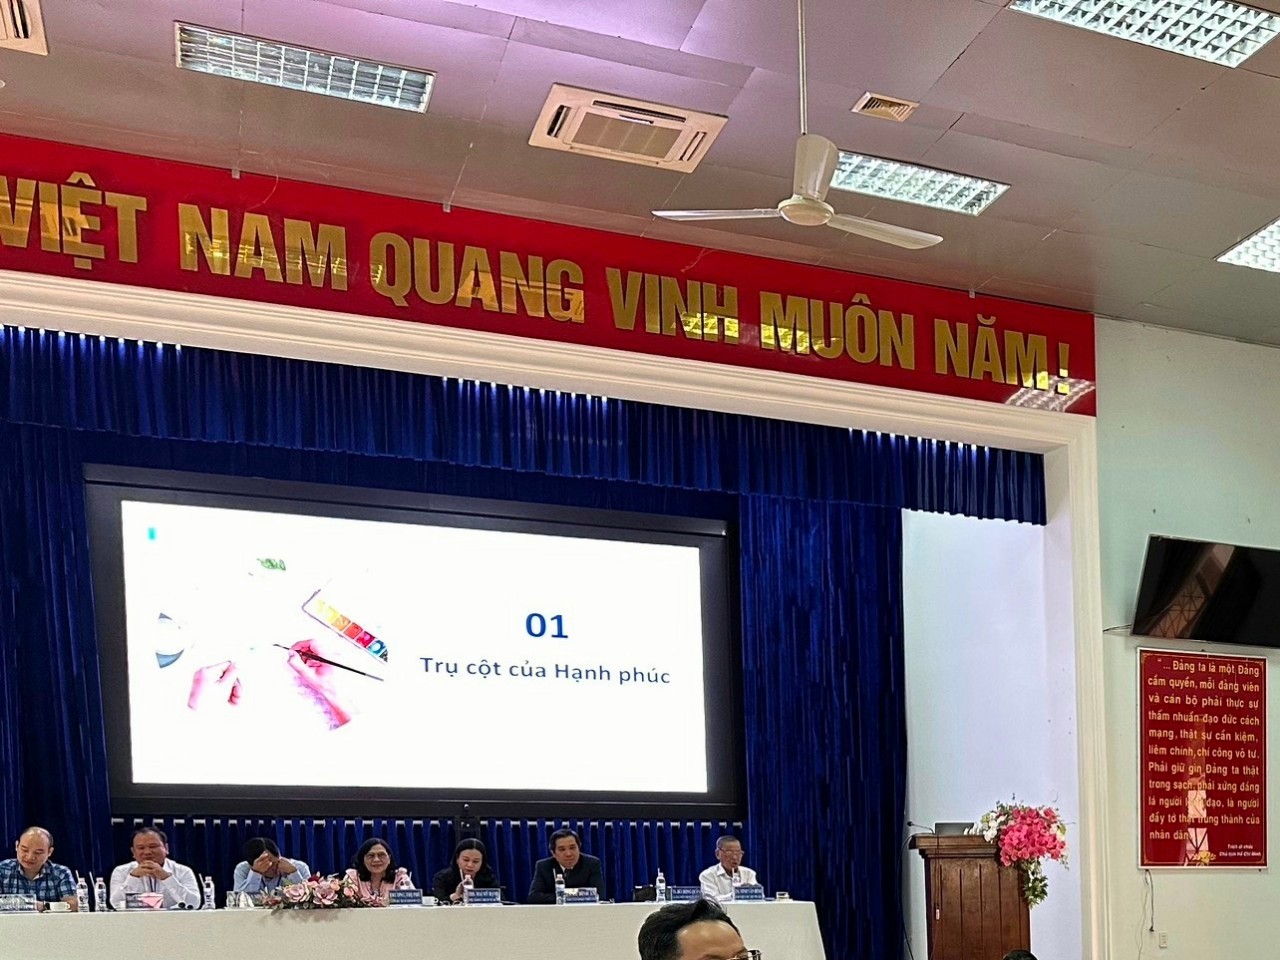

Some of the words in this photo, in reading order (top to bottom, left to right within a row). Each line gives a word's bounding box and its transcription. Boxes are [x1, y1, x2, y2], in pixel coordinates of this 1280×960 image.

[0, 171, 147, 270] VIỆT
[178, 203, 347, 291] NAM
[367, 231, 586, 323] QUANG
[605, 267, 739, 345] VINH
[759, 291, 916, 371] MUÔN
[525, 612, 568, 639] 01
[419, 657, 458, 677] Trụ
[466, 659, 501, 679] cột
[508, 660, 547, 678] của
[554, 663, 611, 682] Hạnh
[619, 667, 671, 685] phúc
[1198, 662, 1206, 672] ta
